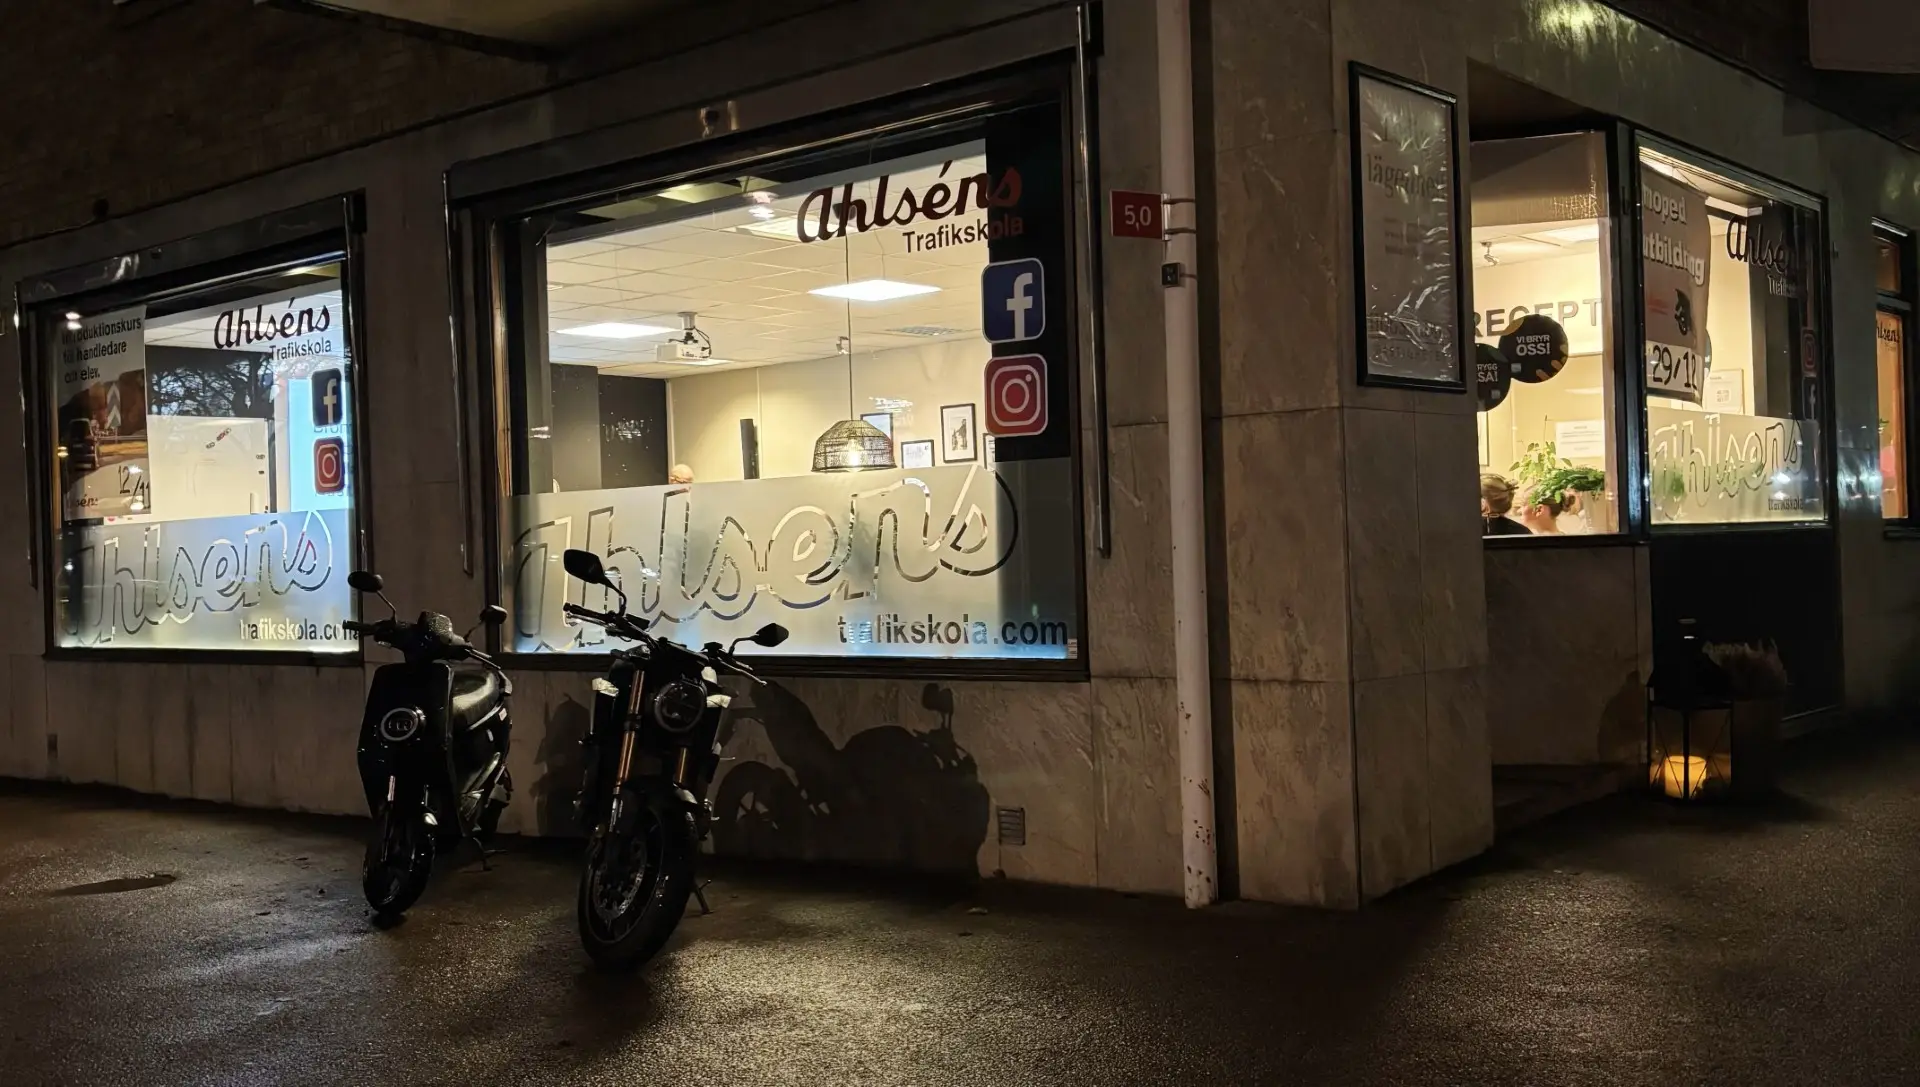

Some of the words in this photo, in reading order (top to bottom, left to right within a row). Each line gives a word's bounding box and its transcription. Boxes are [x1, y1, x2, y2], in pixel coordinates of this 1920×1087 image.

[1124, 204, 1152, 232] 5,0
[902, 213, 1024, 253] Trafikskola
[77, 340, 127, 361] handledare
[269, 338, 331, 361] Trafikskola
[1516, 335, 1525, 344] VI
[1526, 334, 1550, 343] BRYR
[1516, 342, 1551, 356] OSS!
[837, 613, 1068, 646] trafikskola.com
